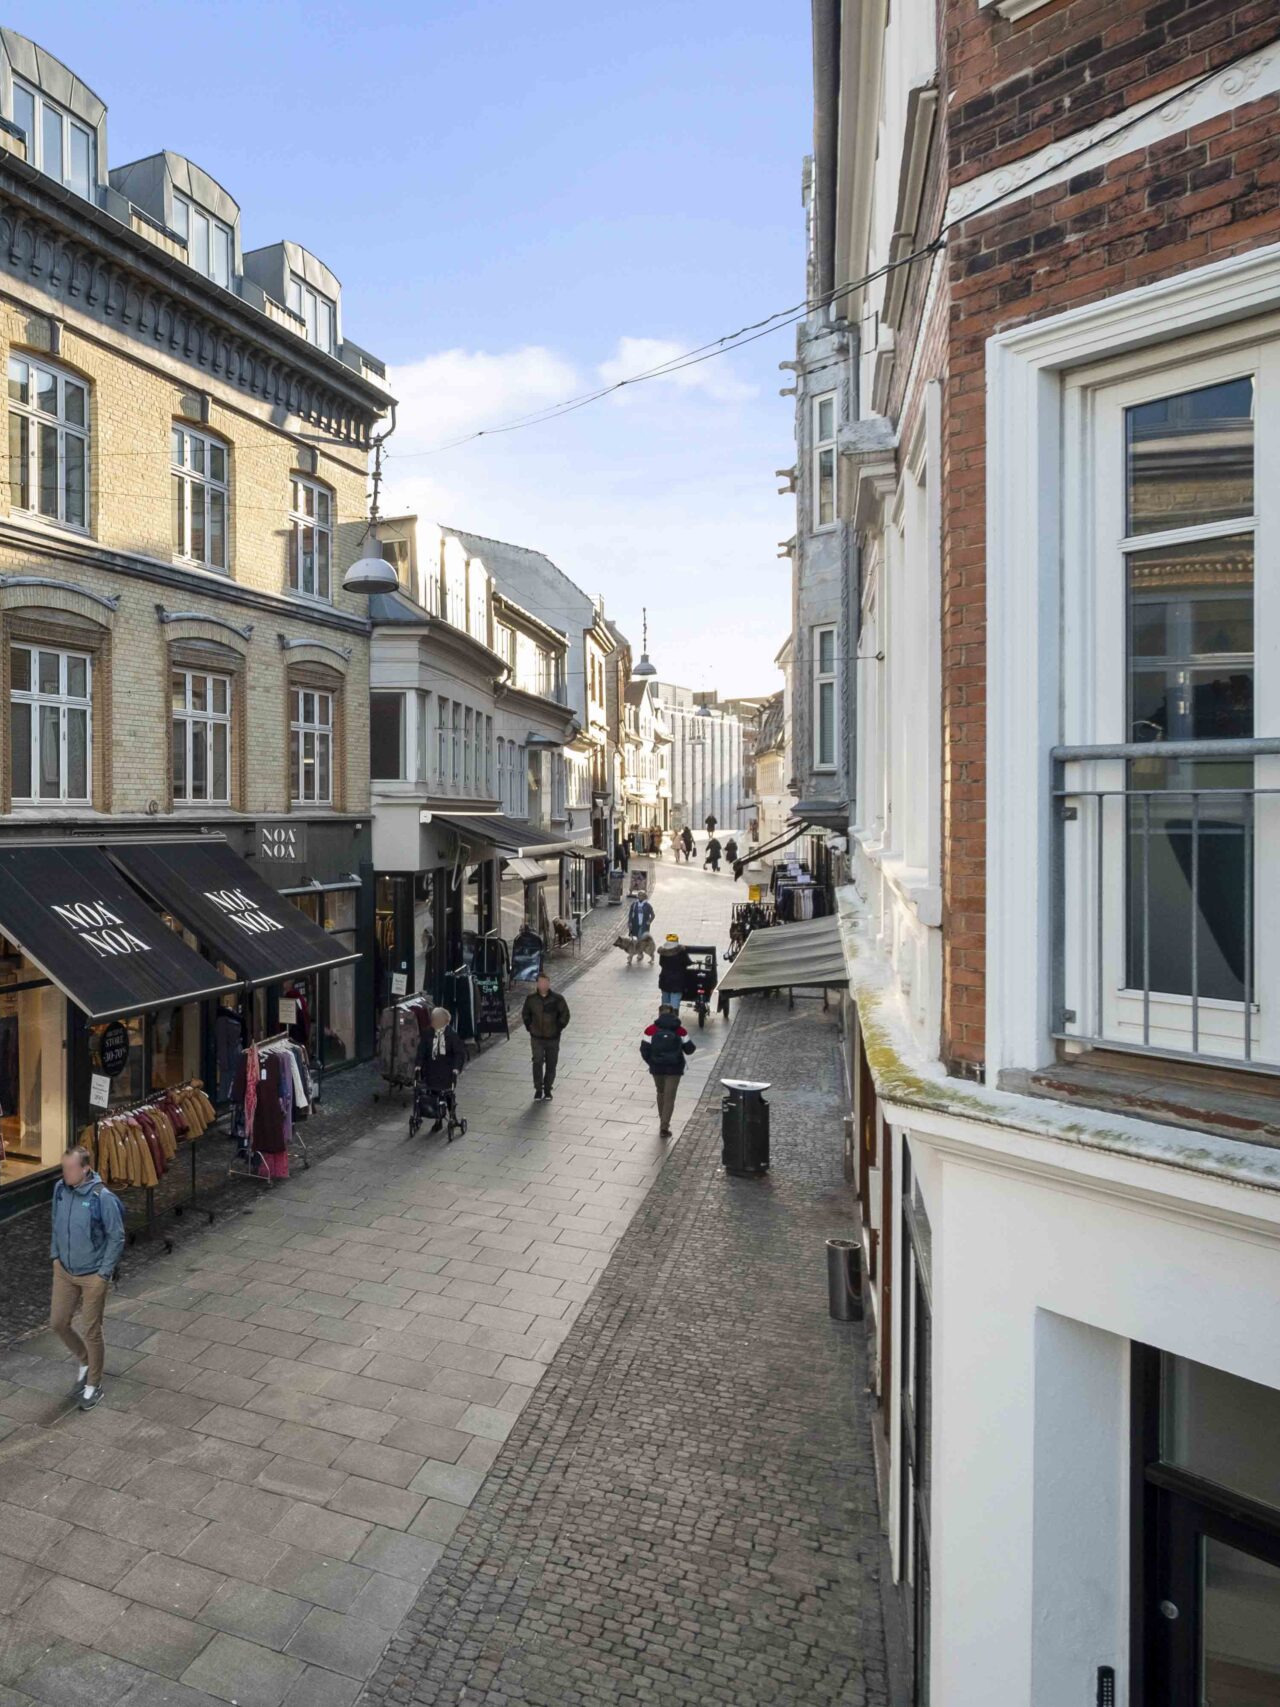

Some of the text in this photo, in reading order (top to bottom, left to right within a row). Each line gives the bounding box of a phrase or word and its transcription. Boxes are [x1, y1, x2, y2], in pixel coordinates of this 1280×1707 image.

[261, 843, 296, 858] NOA
[228, 910, 285, 935] NOA
[78, 927, 152, 957] NOA
